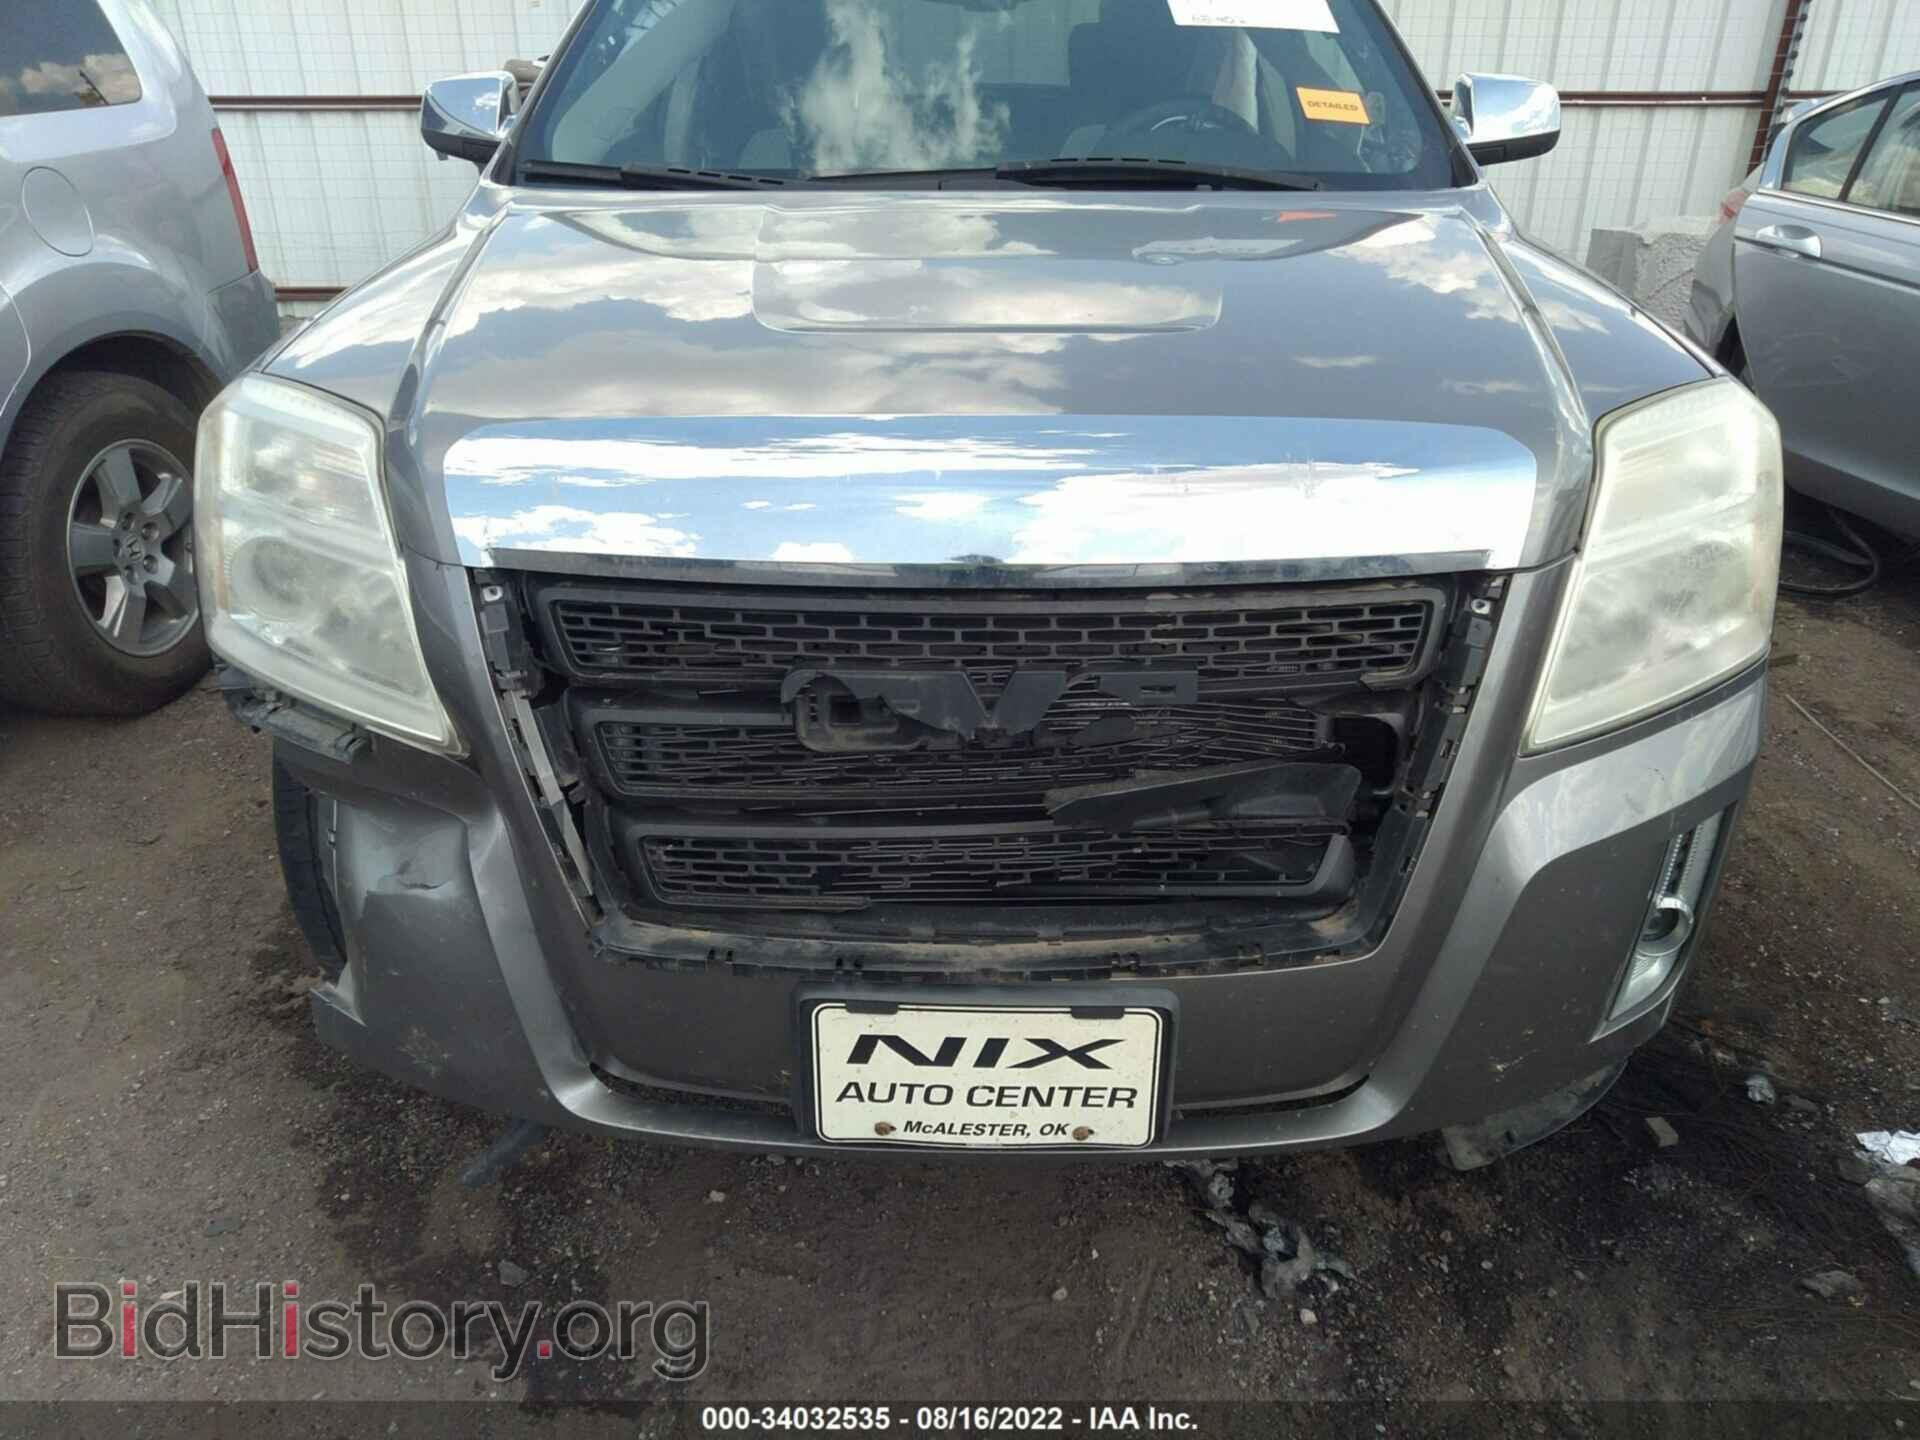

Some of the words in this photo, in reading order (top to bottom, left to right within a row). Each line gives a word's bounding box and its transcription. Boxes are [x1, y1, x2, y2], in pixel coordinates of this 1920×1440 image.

[1307, 101, 1359, 112] DETAILED
[846, 1034, 1126, 1069] NIX
[836, 1082, 953, 1106] AUTO
[967, 1085, 1138, 1109] CENTER
[903, 1120, 1032, 1138] McALESTER,
[1039, 1123, 1072, 1137] OK
